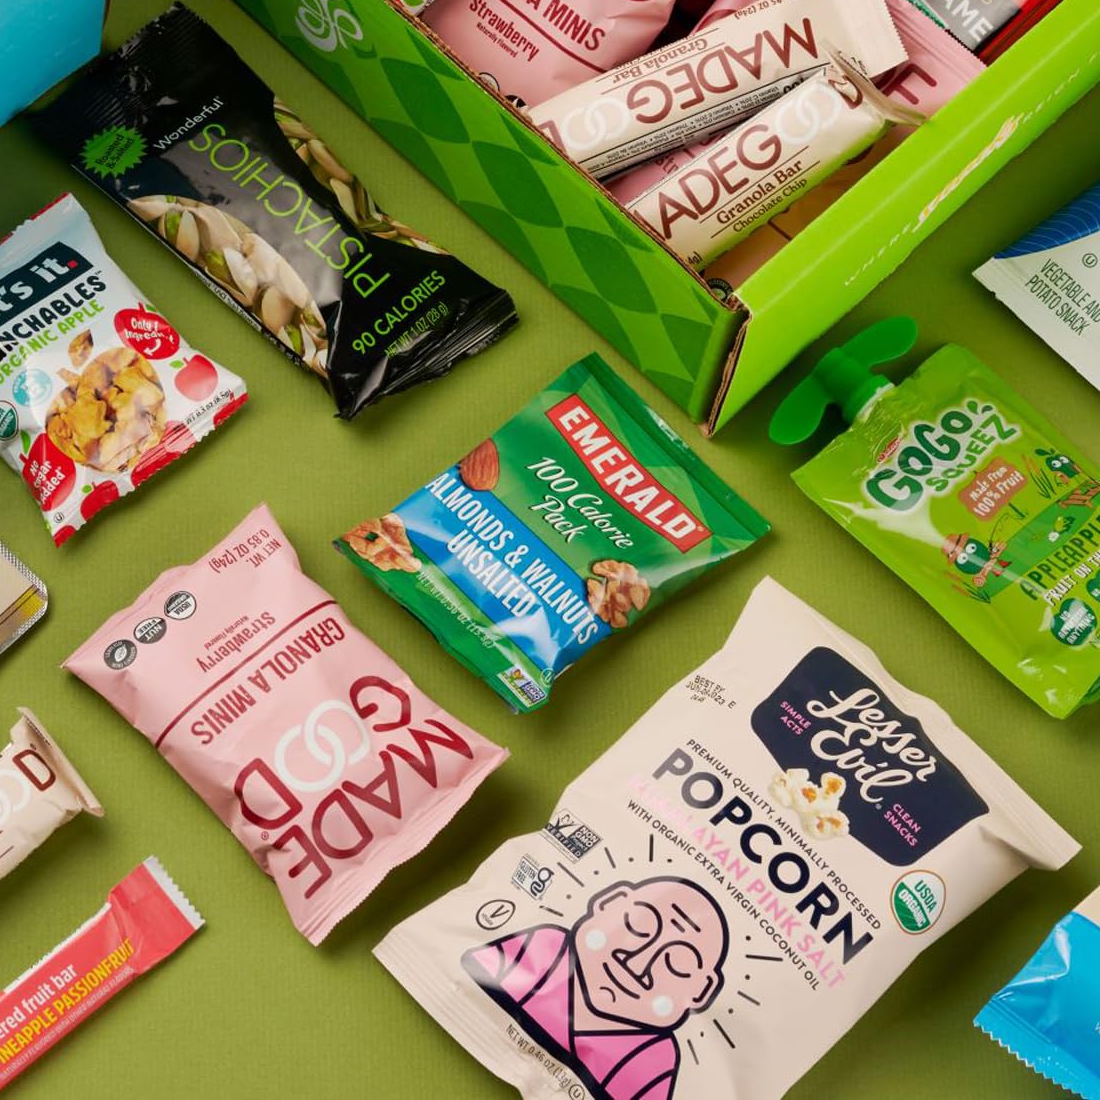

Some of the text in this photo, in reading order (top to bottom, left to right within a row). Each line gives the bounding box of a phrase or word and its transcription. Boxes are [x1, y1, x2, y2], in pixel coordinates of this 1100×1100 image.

[545, 0, 607, 51] MINIS
[154, 98, 224, 151] Wonderful
[188, 124, 390, 298] PISTACHIOS
[716, 160, 803, 225] Granola Bar
[732, 177, 808, 233] Chocolate Chip
[352, 334, 376, 355] 90
[374, 270, 446, 336] CALORIES
[1024, 274, 1090, 336] POTATO SNACK
[1040, 258, 1091, 307] VEGETABLE
[59, 299, 104, 334] APPLE
[527, 456, 635, 549] 100 Calorie
[558, 404, 697, 540] EMERALD
[209, 529, 270, 574] 0.85 OZ (24g)
[264, 539, 282, 558] NET
[530, 495, 587, 543] Pack
[425, 474, 599, 645] ALMONDS & WALNUTS
[447, 529, 537, 618] UNSALTED
[195, 612, 276, 673] Strawberry
[190, 617, 346, 745] GRANOLA MINIS
[780, 701, 812, 729] SIMPLE
[780, 714, 803, 736] ACTS
[807, 688, 938, 783] Lesser
[234, 675, 412, 828] GOOD
[811, 724, 913, 803] Evil
[284, 719, 473, 900] MADE
[686, 739, 881, 930] PREMIUM QUALITY, MINIMALLY PROCESSED
[883, 811, 918, 847] SNACKS
[892, 803, 922, 833] CLEAN
[652, 748, 874, 965] POPCORN
[627, 800, 820, 991] WITH ORGANIC EXTRA VIRGIN COCONUT OIL
[913, 880, 938, 913] USDA
[746, 878, 846, 989] PINK SALT
[19, 984, 56, 1015] fruit
[51, 963, 78, 989] bar
[55, 938, 134, 1014] PASSIONFRUIT
